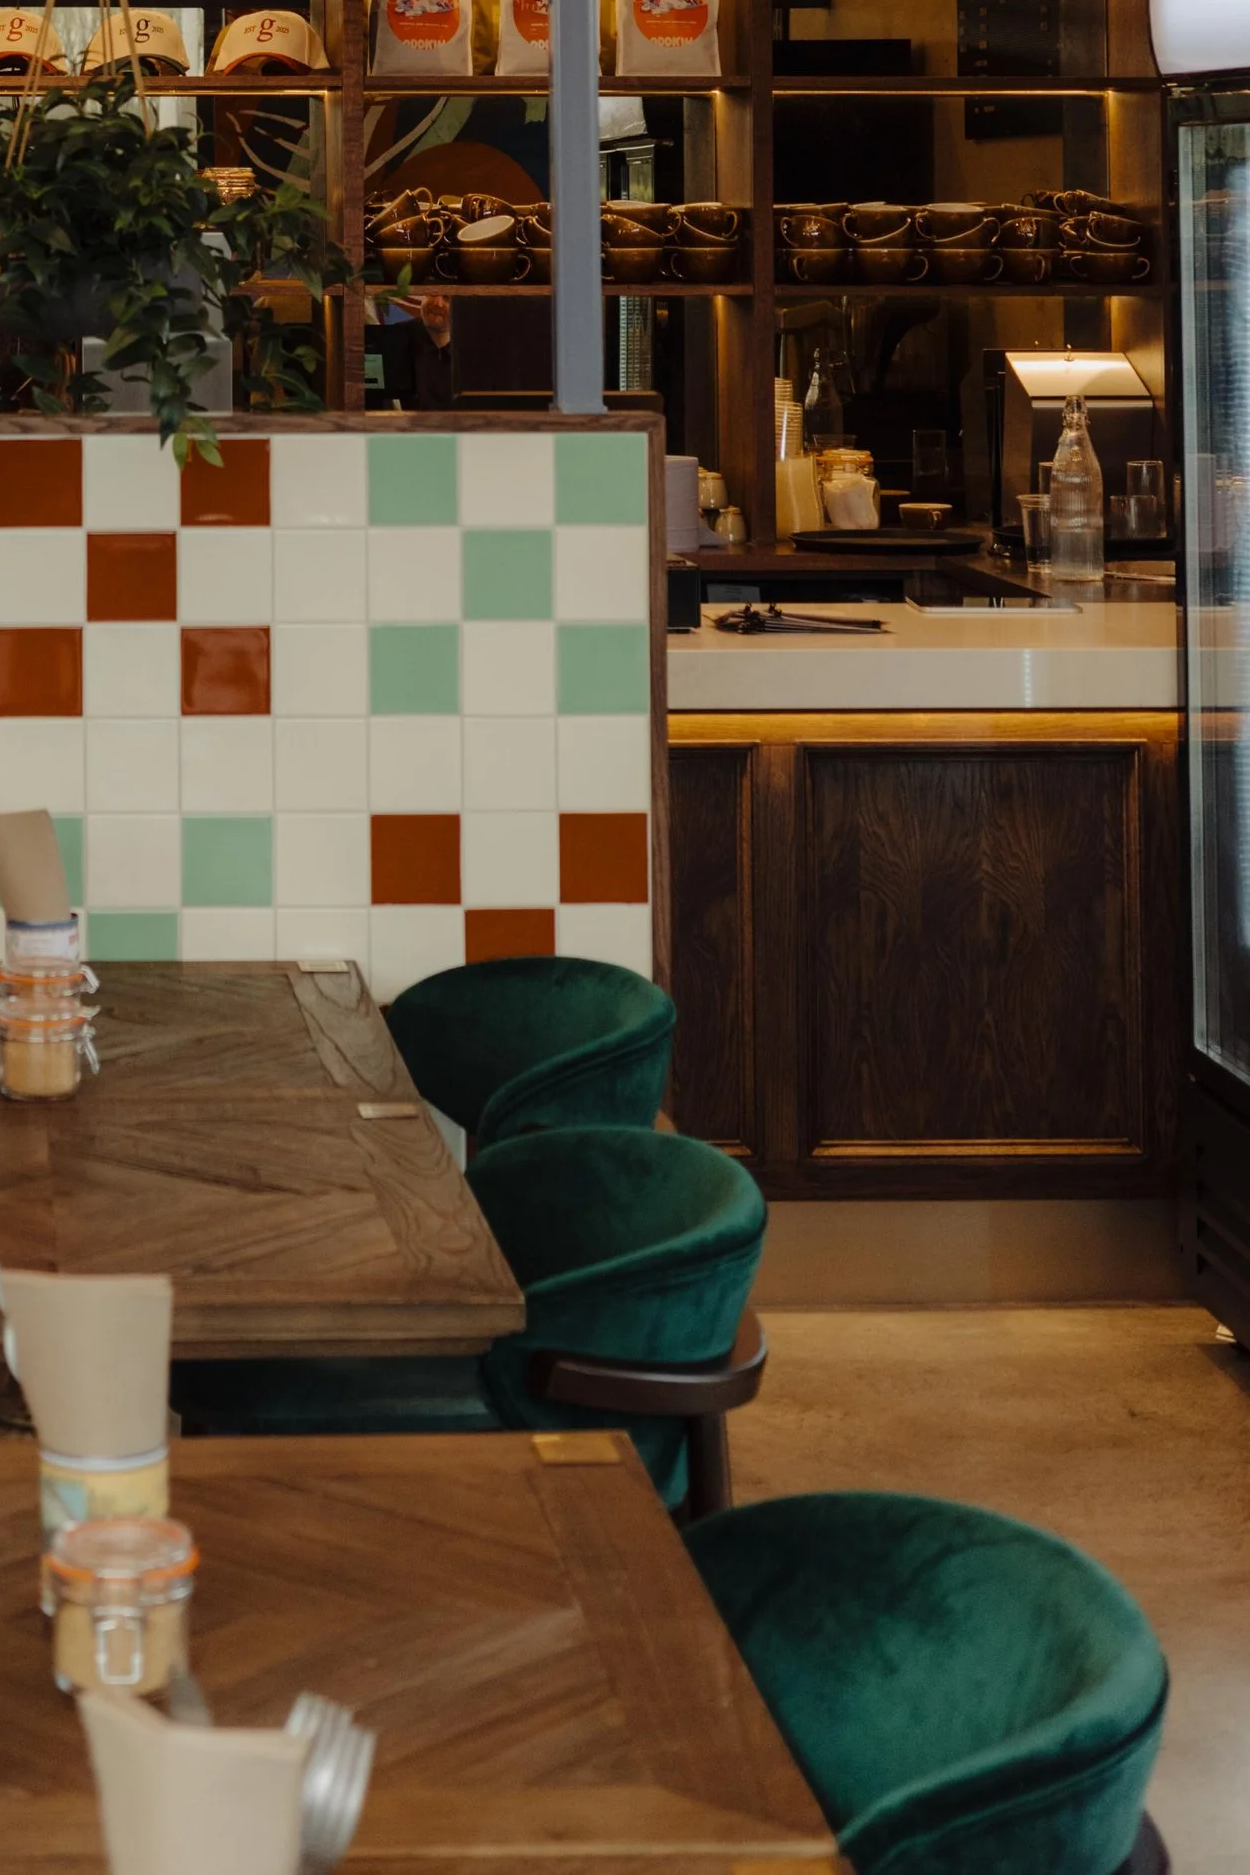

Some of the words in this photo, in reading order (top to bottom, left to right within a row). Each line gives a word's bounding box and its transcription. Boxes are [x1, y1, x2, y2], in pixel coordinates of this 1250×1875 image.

[6, 17, 25, 41] g
[134, 18, 151, 43] g
[244, 25, 257, 34] EST
[257, 18, 276, 42] g
